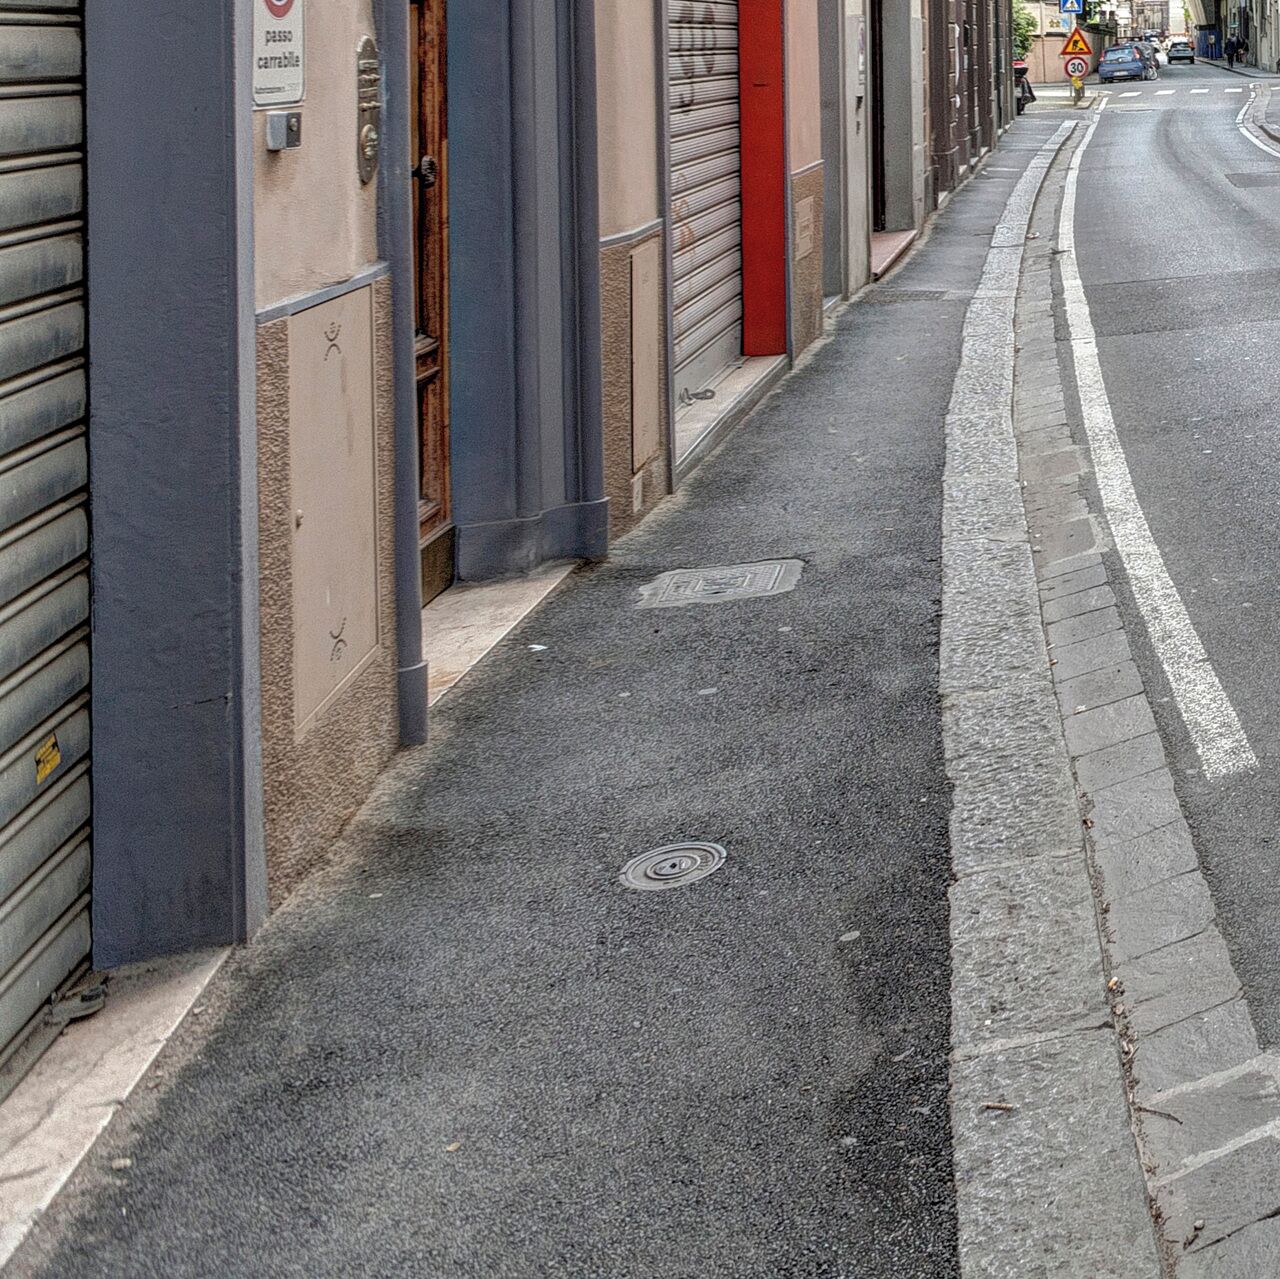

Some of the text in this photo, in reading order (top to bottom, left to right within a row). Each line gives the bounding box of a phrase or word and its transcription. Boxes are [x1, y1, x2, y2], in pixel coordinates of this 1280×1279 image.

[265, 29, 293, 47] passo
[257, 51, 300, 70] carrabile
[1070, 62, 1085, 74] 30
